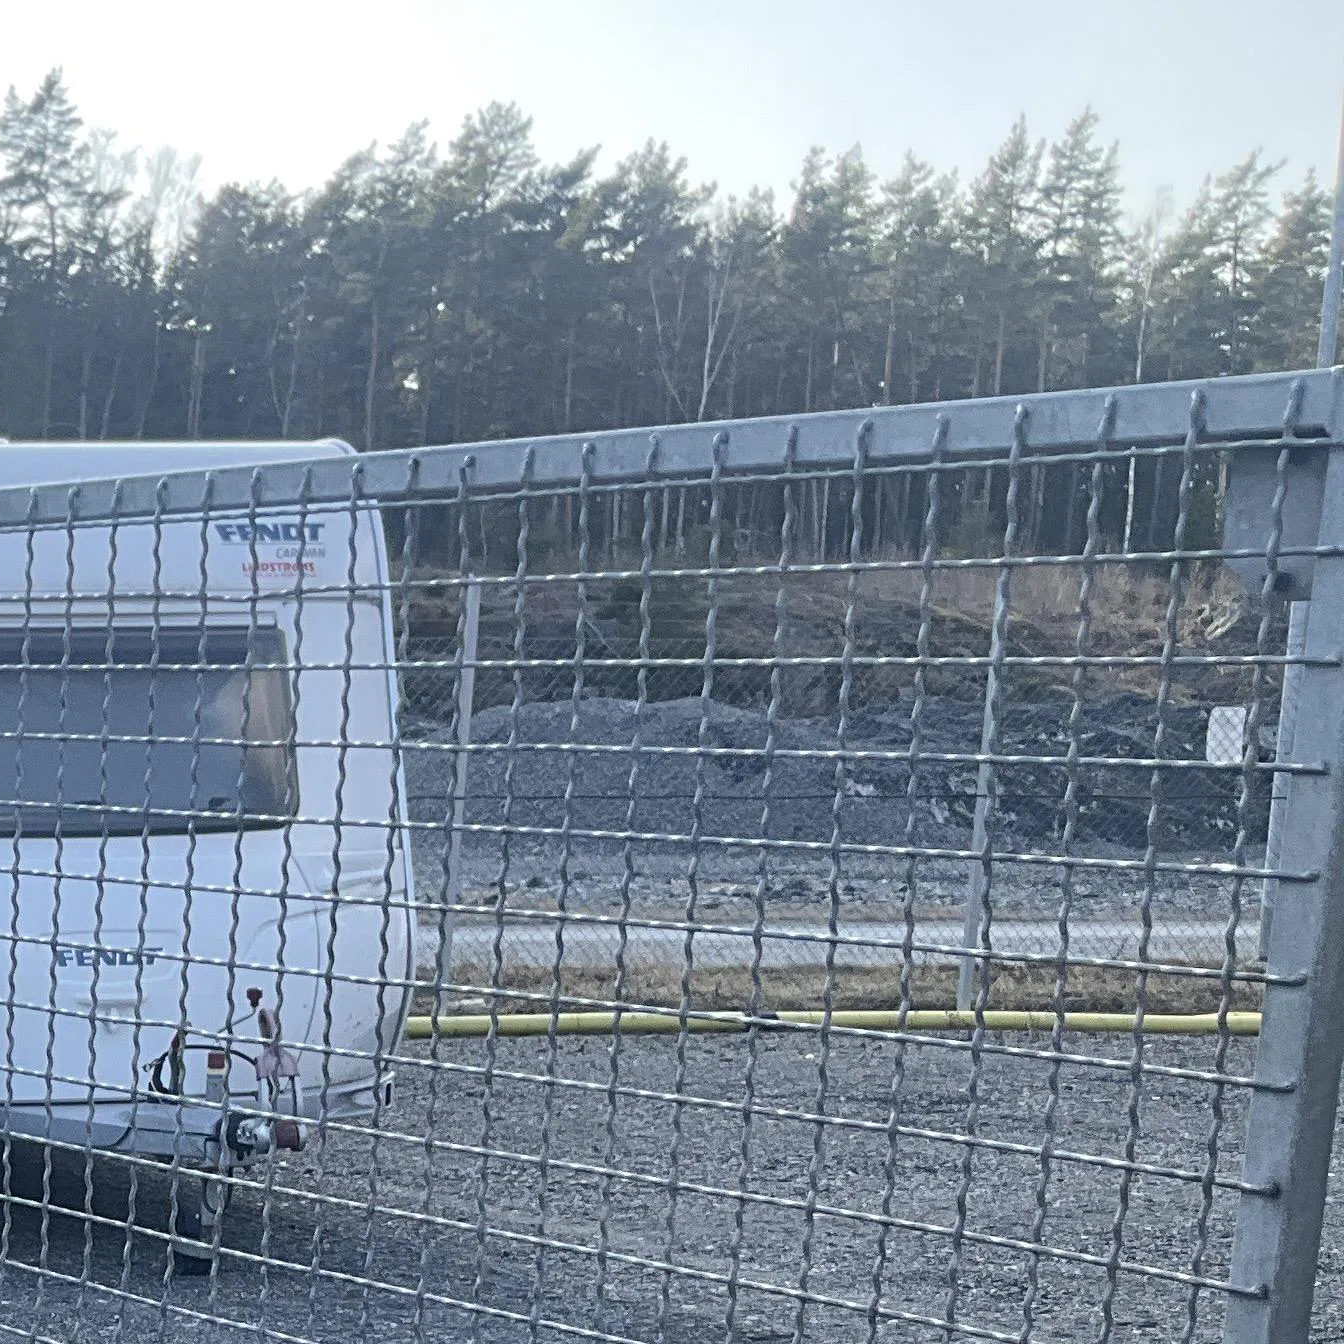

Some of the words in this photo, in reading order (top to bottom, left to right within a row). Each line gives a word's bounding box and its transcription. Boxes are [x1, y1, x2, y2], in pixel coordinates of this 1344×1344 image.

[214, 523, 325, 541] FENDT
[275, 548, 326, 559] CARVAN
[56, 947, 163, 966] FENDT
